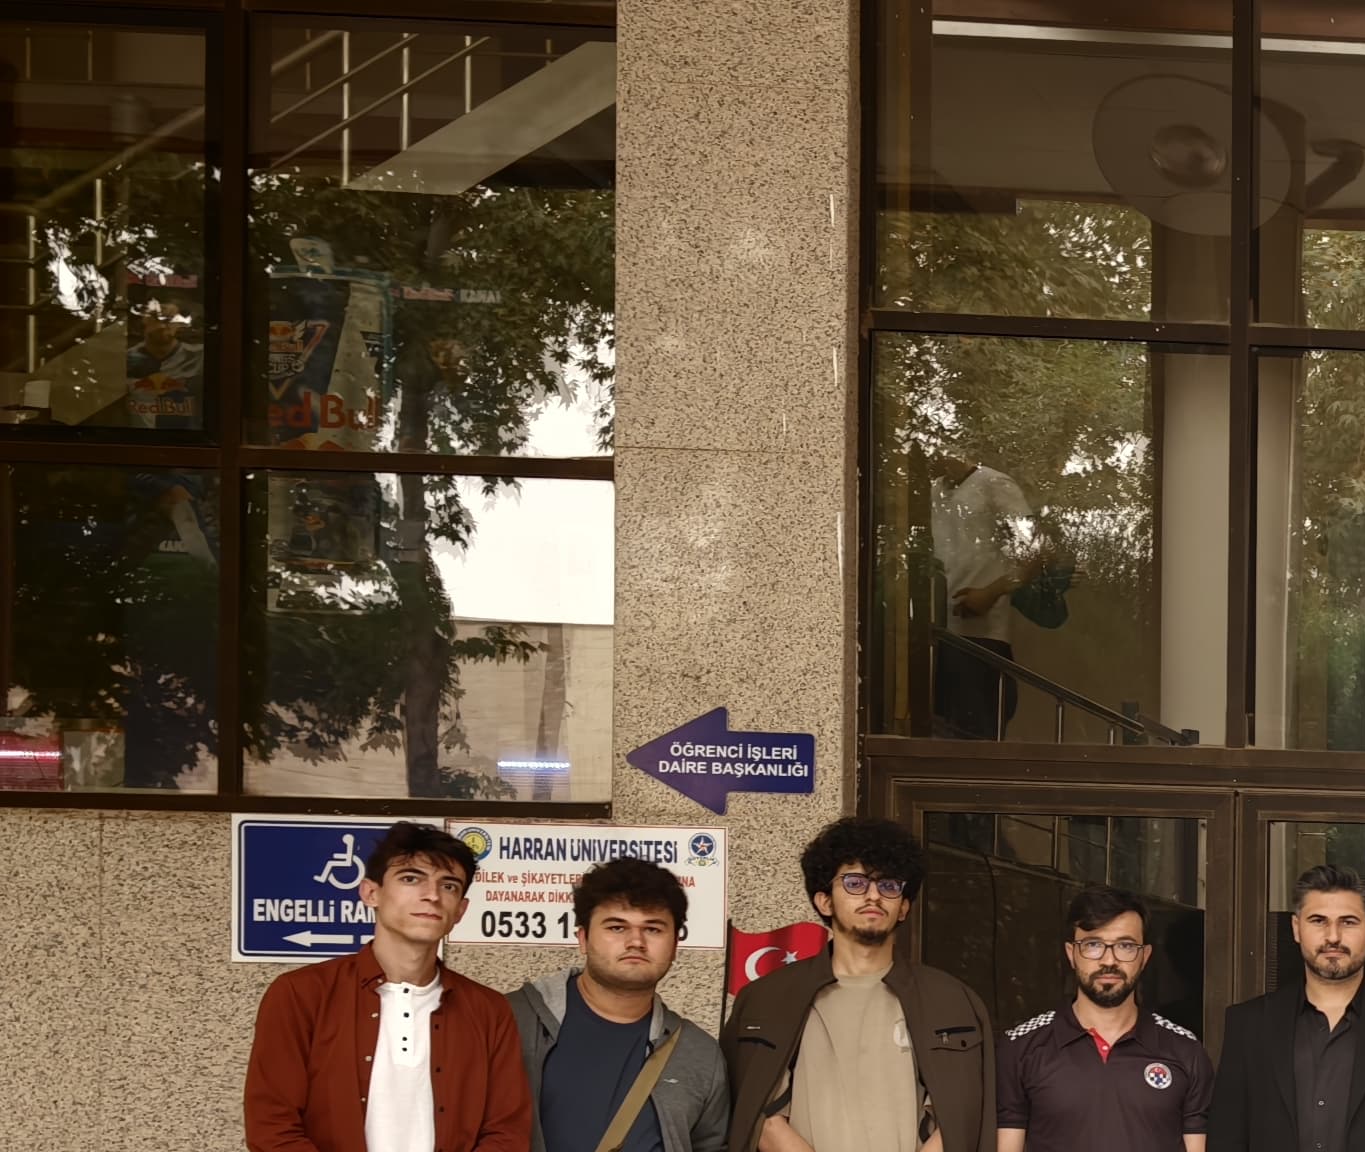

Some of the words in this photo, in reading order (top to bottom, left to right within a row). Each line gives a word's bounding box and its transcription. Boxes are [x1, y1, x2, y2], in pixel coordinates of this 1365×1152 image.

[165, 397, 193, 416] Bull
[268, 391, 312, 429] ed
[670, 742, 743, 759] ÖĞRENCİ
[747, 744, 798, 762] İŞLERİ
[658, 758, 707, 774] DAİRE
[711, 761, 809, 778] BAŞKANLIĞI
[499, 836, 567, 861] HARRAN
[475, 870, 505, 883] DİLEK
[507, 874, 519, 884] ve
[521, 871, 584, 888] ŞİKAYETLER
[486, 890, 545, 902] DAYANARAK
[548, 890, 574, 904] DİKK
[480, 910, 547, 939] 0533
